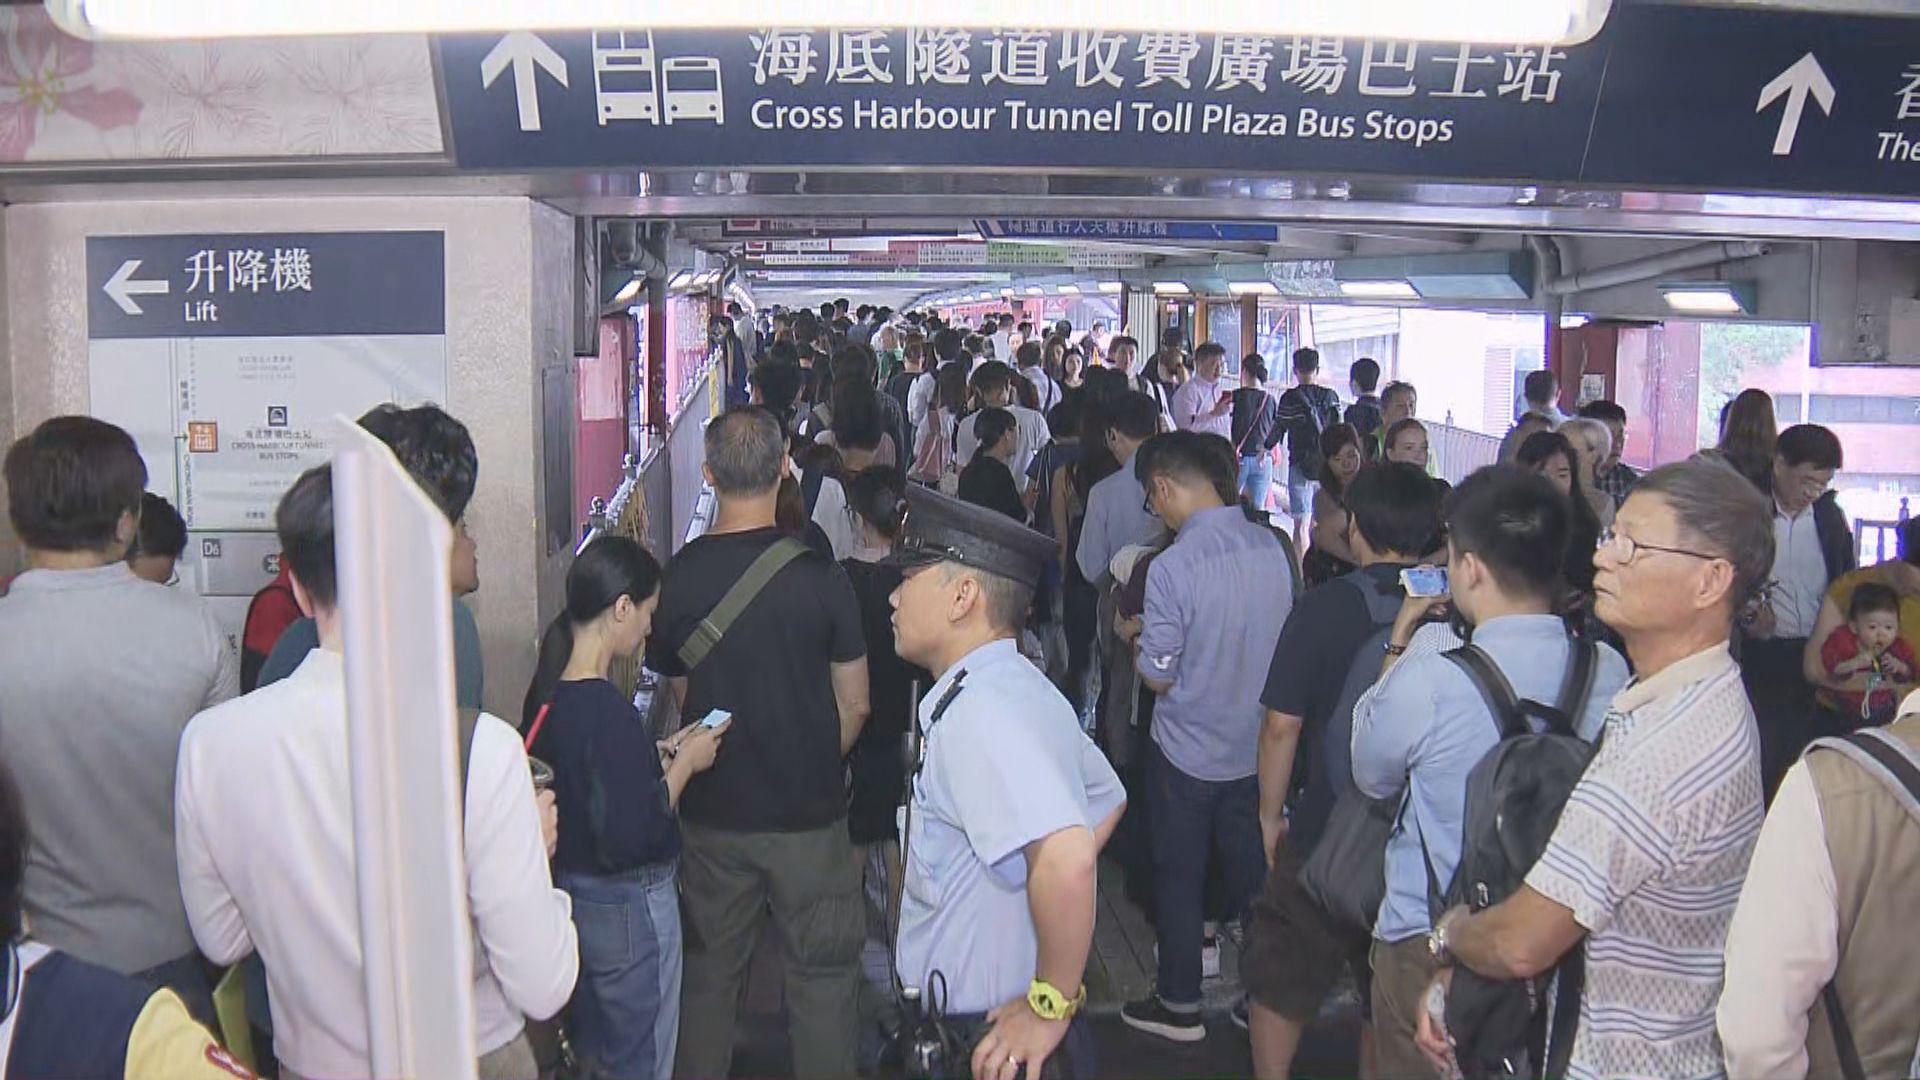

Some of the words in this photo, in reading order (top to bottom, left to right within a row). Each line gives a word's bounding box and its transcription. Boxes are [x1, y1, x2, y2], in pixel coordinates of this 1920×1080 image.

[748, 27, 1567, 103] 海底隧道收費廣場巴士站
[751, 99, 843, 130] Cross
[854, 98, 997, 131] Harbour
[1004, 99, 1121, 132] Tunnel
[1132, 102, 1192, 134] Toll
[1202, 103, 1287, 137] Plaza
[1297, 106, 1355, 139] Bus
[1363, 109, 1454, 147] Stops
[183, 248, 313, 295] 升降機
[184, 301, 218, 322] Lift
[204, 542, 220, 557] D6
